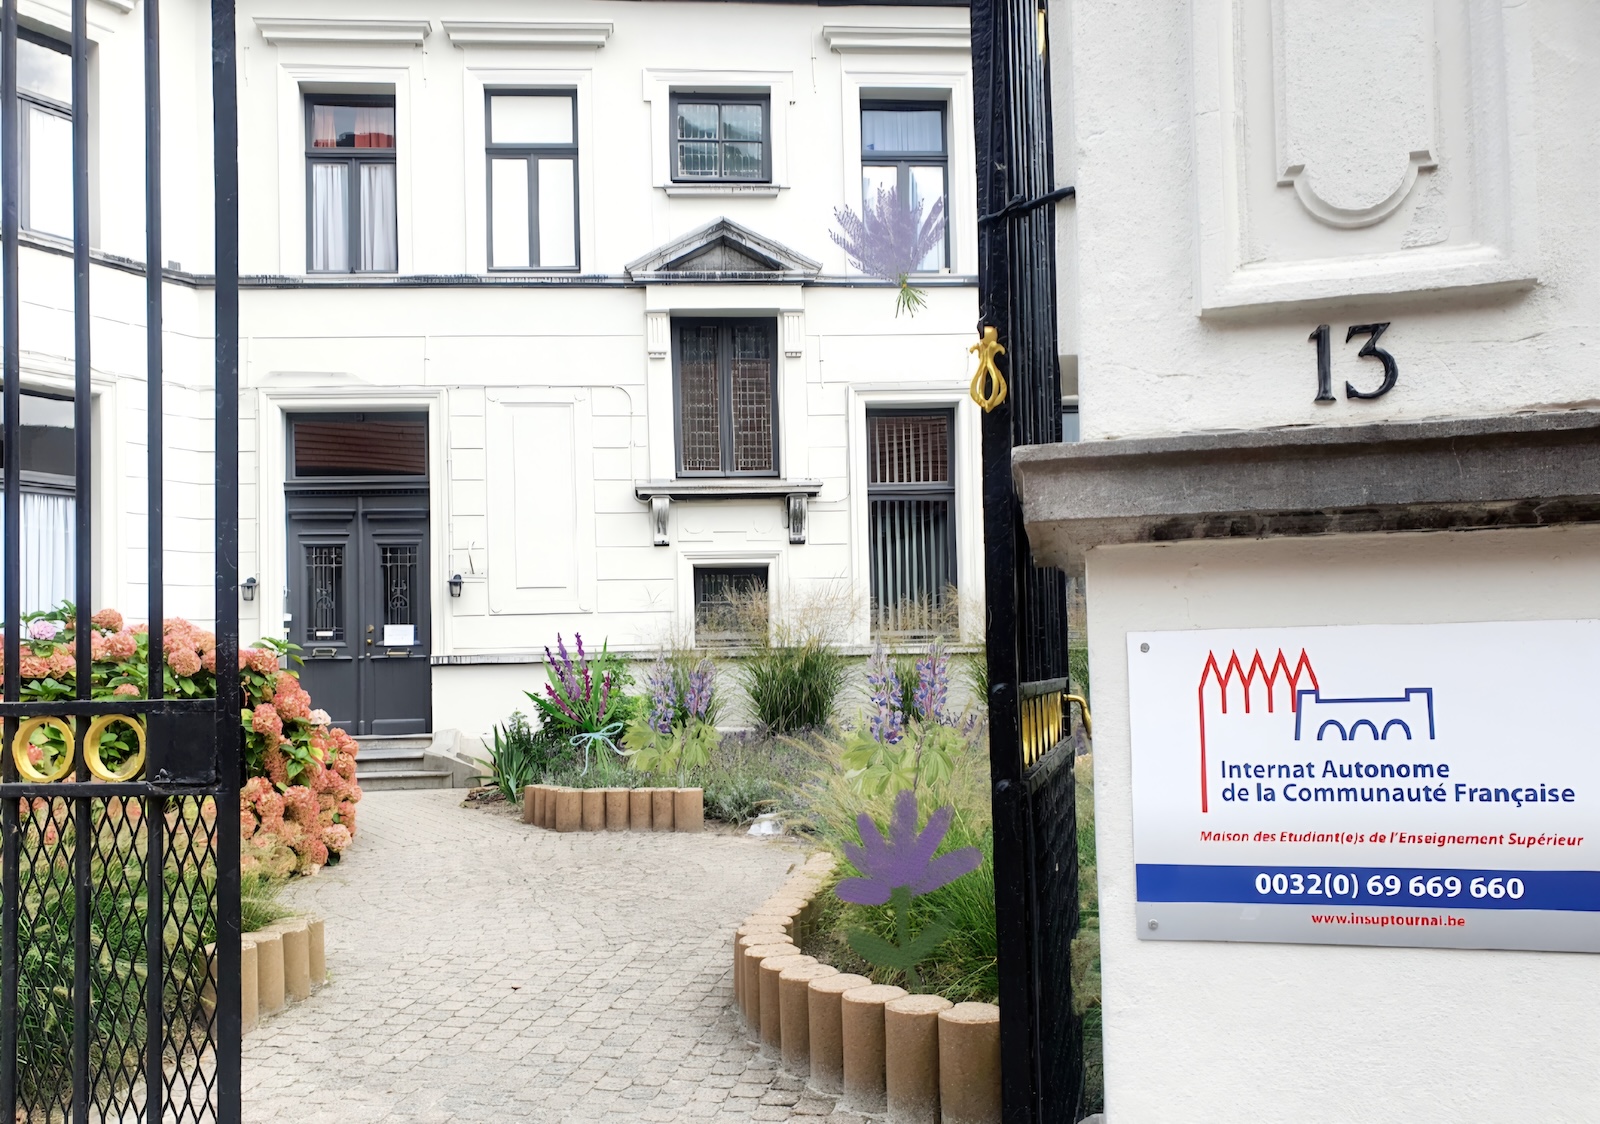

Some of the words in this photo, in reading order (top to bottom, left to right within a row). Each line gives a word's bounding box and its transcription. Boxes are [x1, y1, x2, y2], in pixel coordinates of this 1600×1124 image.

[1308, 322, 1399, 401] 13
[1221, 760, 1315, 778] Internat
[1322, 760, 1450, 778] Autonome
[1222, 783, 1249, 802] de
[1256, 783, 1276, 802] la
[1283, 783, 1447, 802] Communauté
[1455, 784, 1575, 808] Française
[1200, 831, 1249, 842] Maison
[1253, 831, 1276, 842] des
[1280, 831, 1364, 845] Etudiant(e)s
[1369, 832, 1386, 844] de
[1508, 832, 1584, 848] Supérieur
[1255, 873, 1359, 898] 0032(0)
[1366, 875, 1401, 896] 69
[1408, 875, 1462, 897] 669
[1469, 877, 1525, 899] 660
